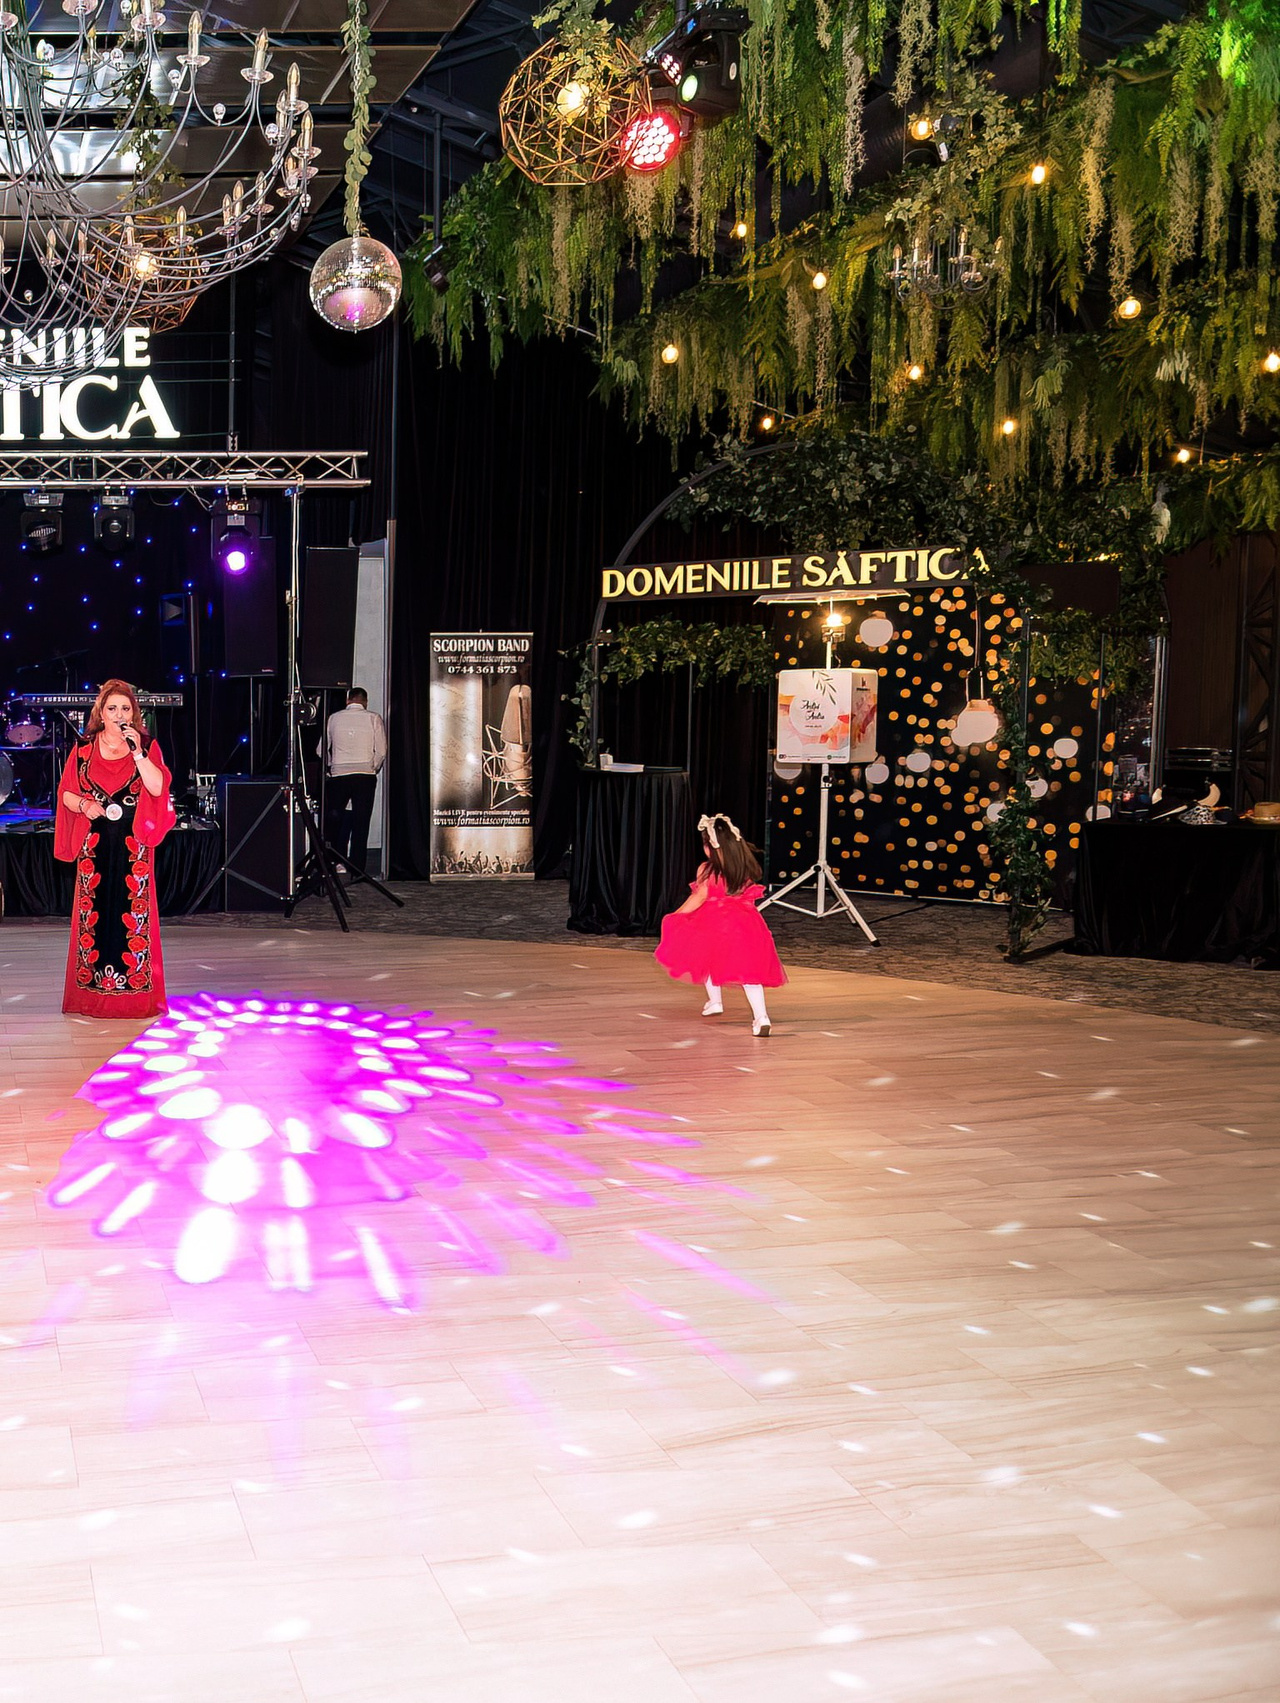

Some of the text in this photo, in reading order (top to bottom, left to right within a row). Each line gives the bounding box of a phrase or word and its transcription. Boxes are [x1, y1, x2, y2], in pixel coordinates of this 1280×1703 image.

[602, 558, 791, 598] DOMENIILE
[433, 639, 530, 652] SCORPION BAND
[448, 666, 518, 674] 0744 361 873
[433, 815, 530, 828] www.formatiascorpion.ro
